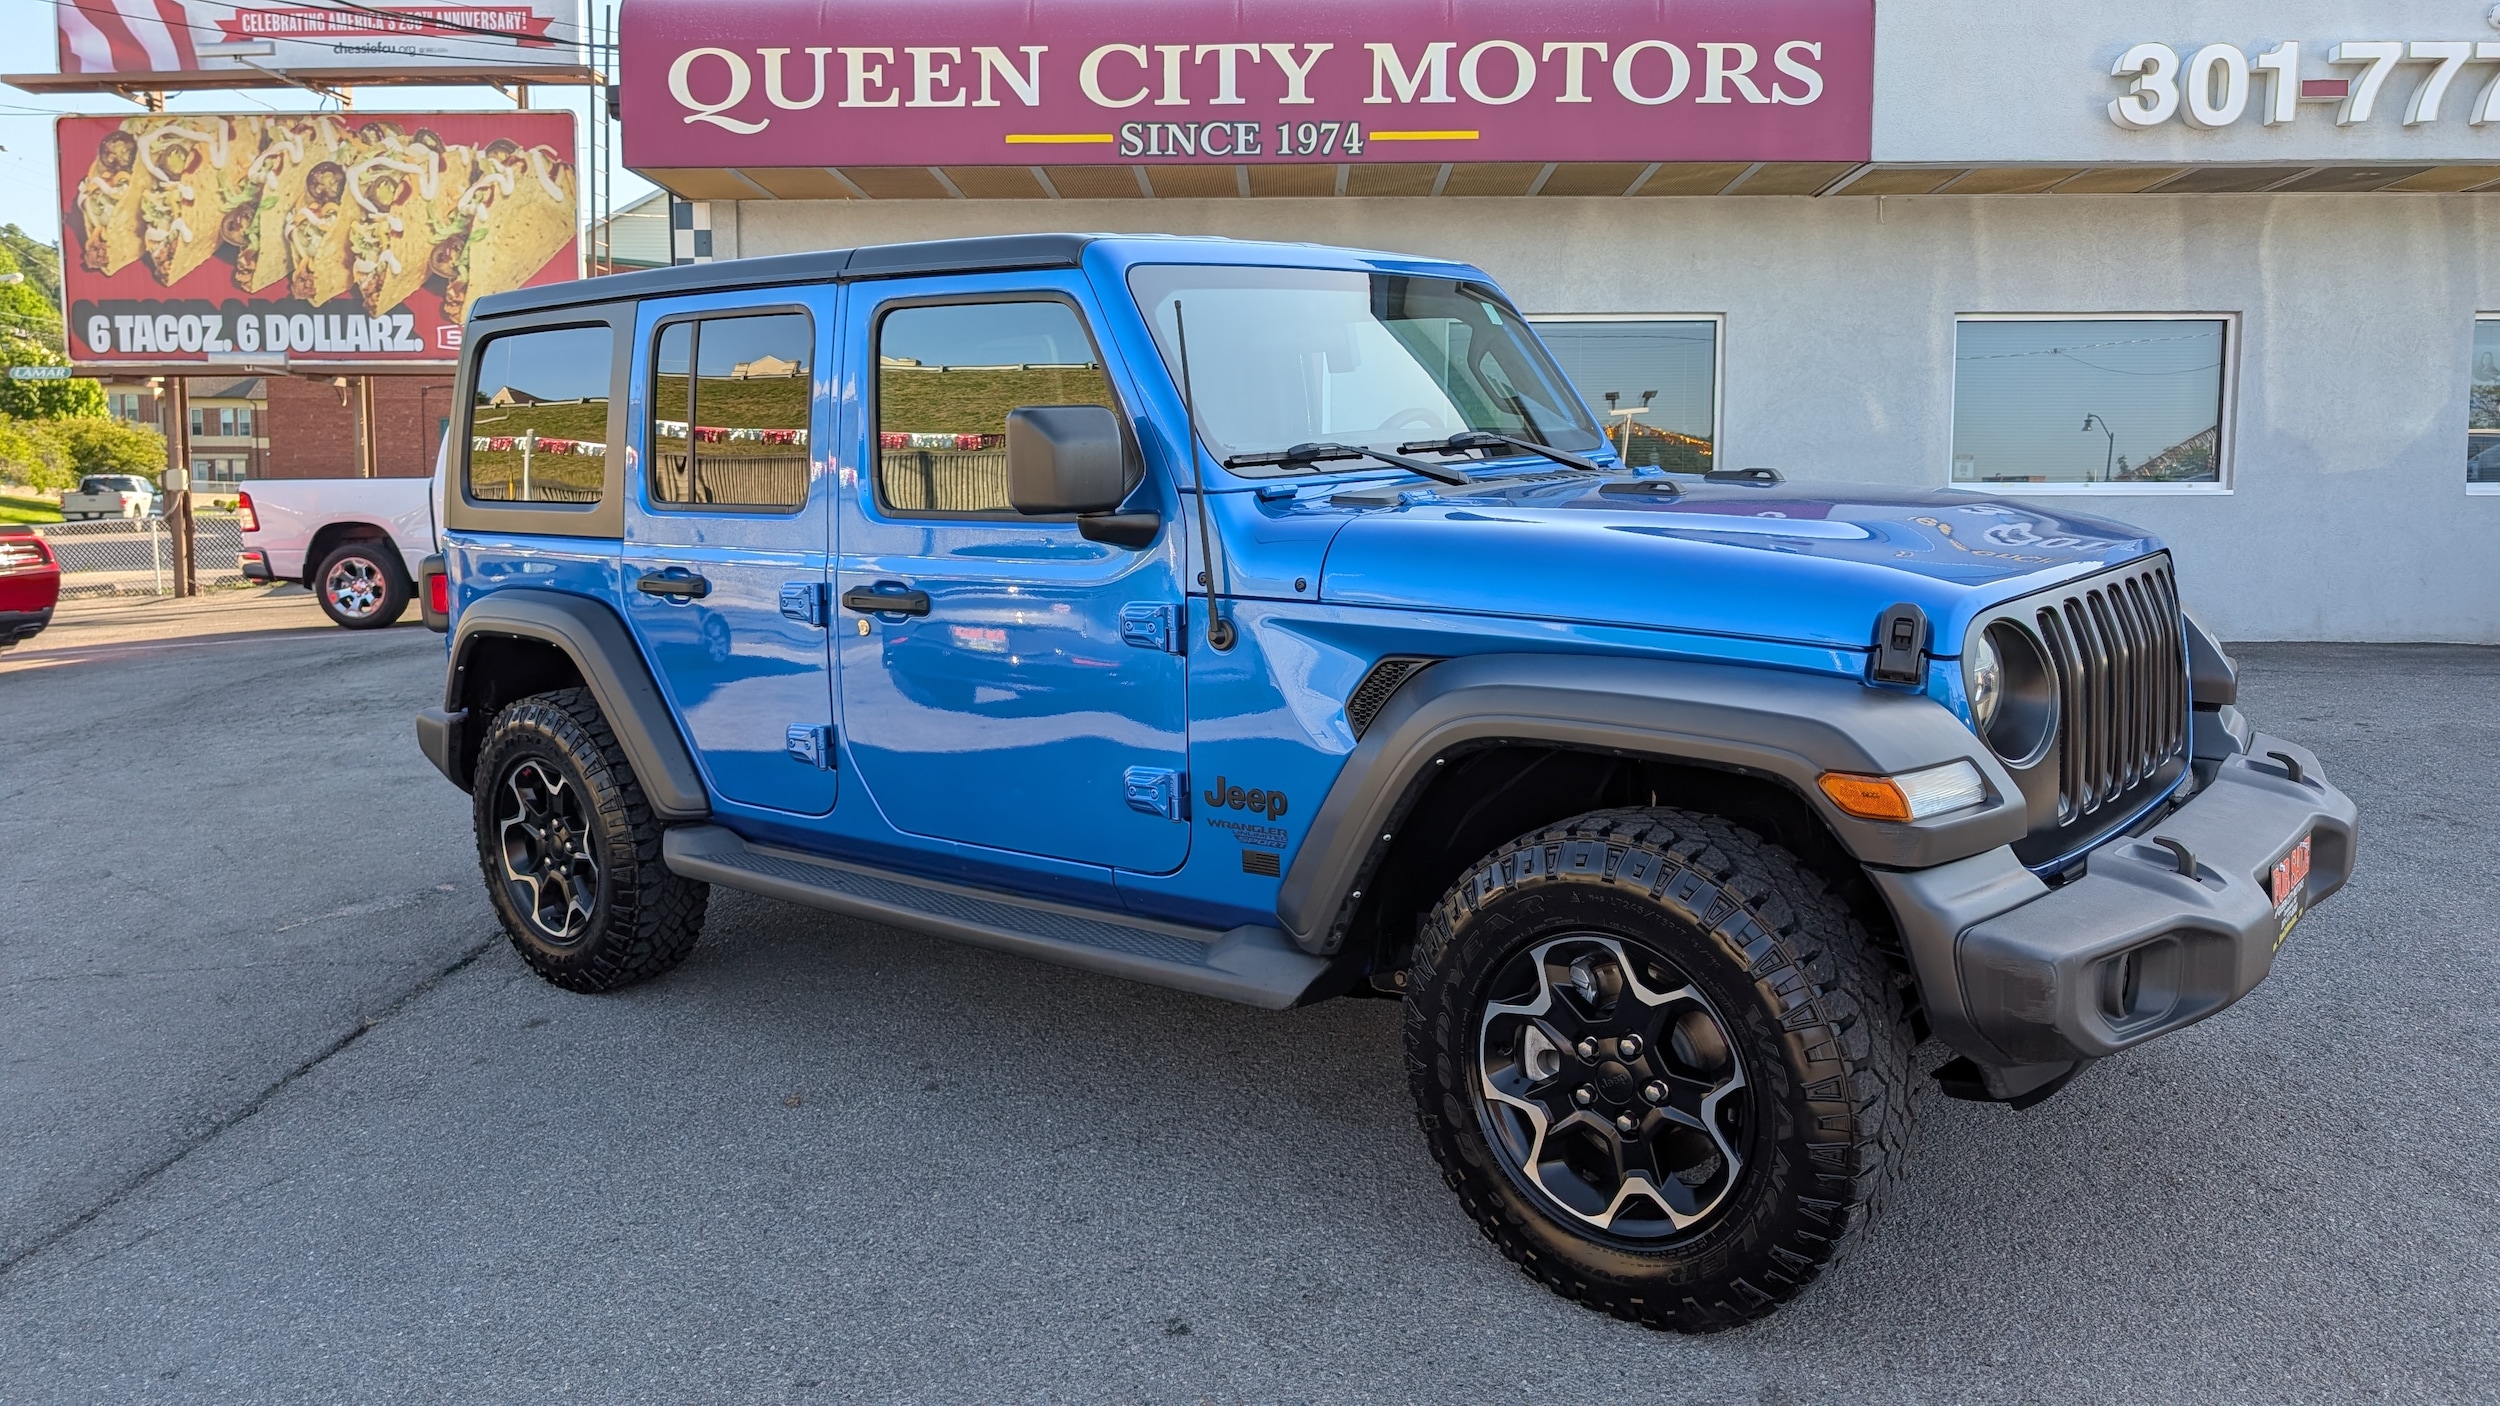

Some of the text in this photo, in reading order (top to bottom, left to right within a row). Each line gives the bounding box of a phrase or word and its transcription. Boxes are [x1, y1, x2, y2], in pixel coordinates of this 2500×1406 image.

[241, 13, 326, 32] CELEBRATING
[328, 11, 396, 31] AMERICA'S
[436, 11, 528, 30] ANNIVERSARY!
[667, 40, 1825, 135] QUEEN CITY MOTORS
[1120, 121, 1364, 156] SINCE 1974
[87, 313, 425, 353] 6 TACOZ. 6 DOLLARZ.
[15, 367, 66, 377] LAMAR
[1204, 776, 1288, 821] Jeep
[1206, 818, 1288, 837] WRANGLER
[1232, 829, 1289, 842] UNLIMITED
[1238, 836, 1288, 848] SPORT
[1601, 1074, 1628, 1089] Jeep
